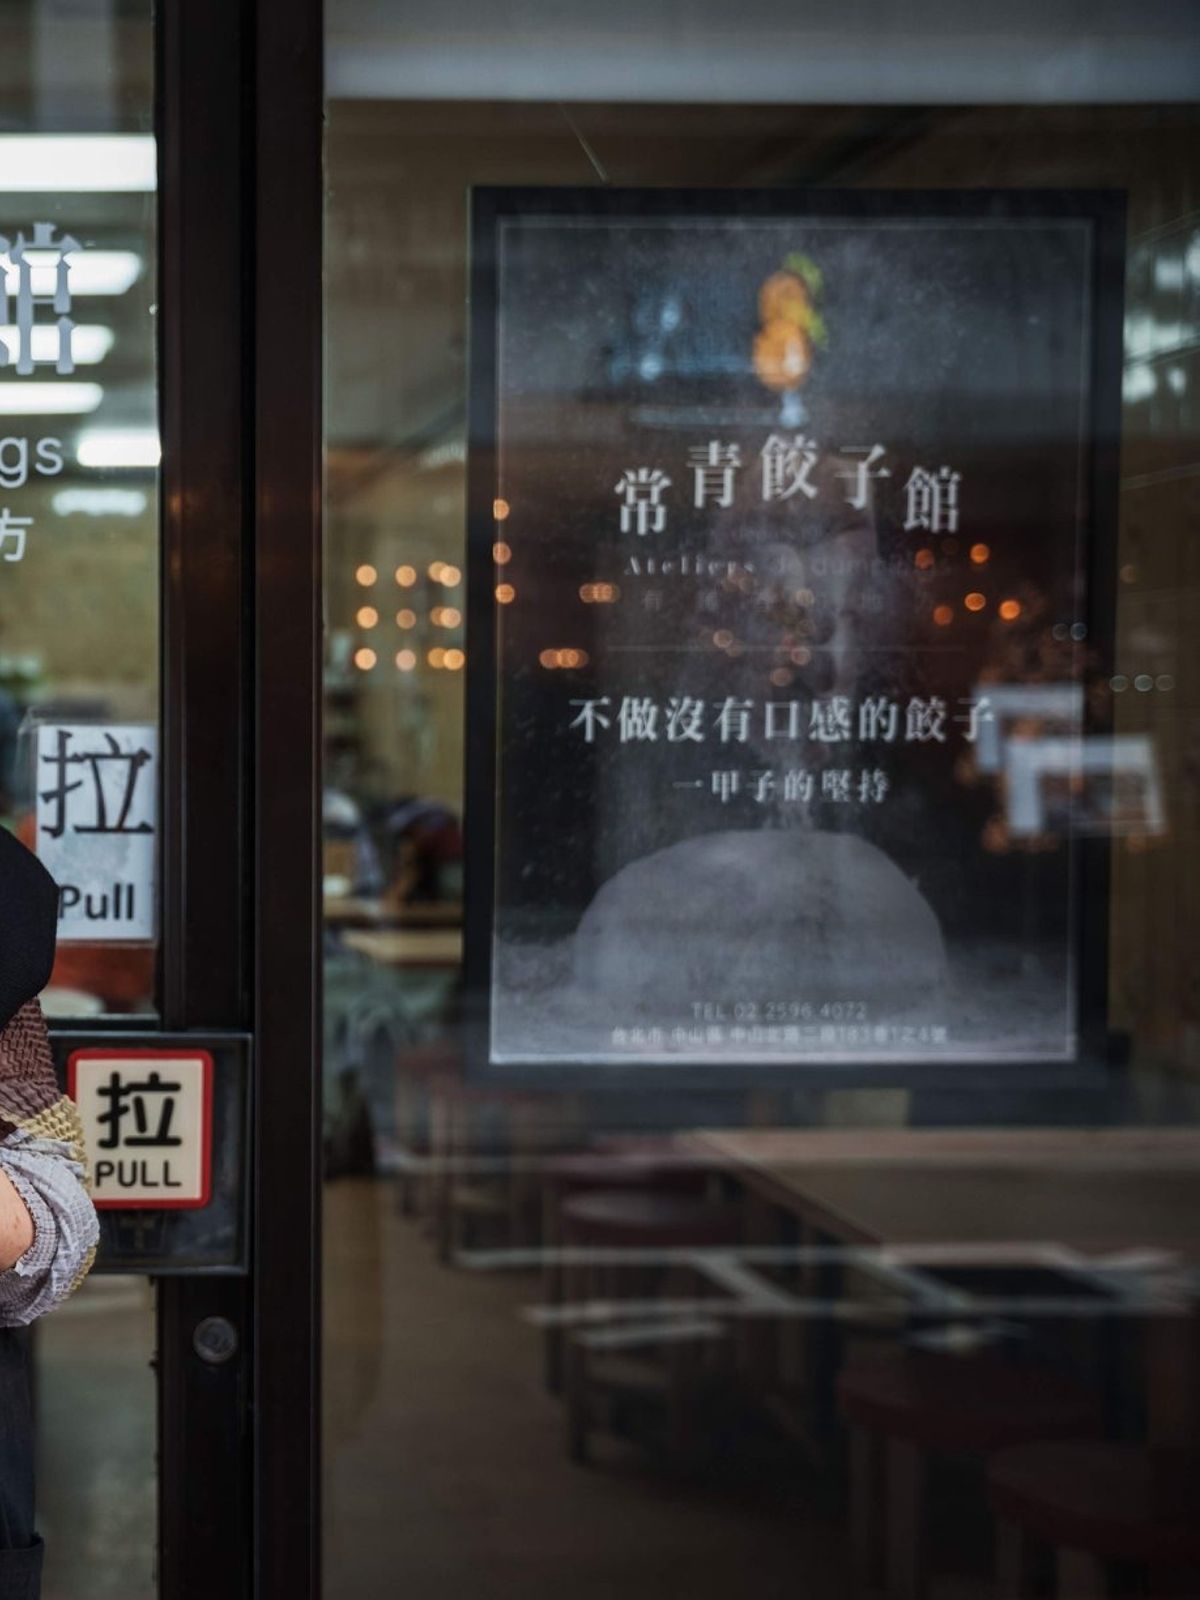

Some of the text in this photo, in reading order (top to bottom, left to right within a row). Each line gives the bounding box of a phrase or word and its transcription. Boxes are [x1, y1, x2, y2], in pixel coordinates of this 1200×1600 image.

[615, 434, 962, 536] 常青餃子館
[568, 696, 997, 744] 不做沒有口感的餃子
[40, 731, 155, 840] 拉
[672, 768, 890, 804] 一甲子的堅持
[58, 883, 135, 921] Pull
[96, 1071, 182, 1149] 拉
[95, 1160, 182, 1188] PULL
